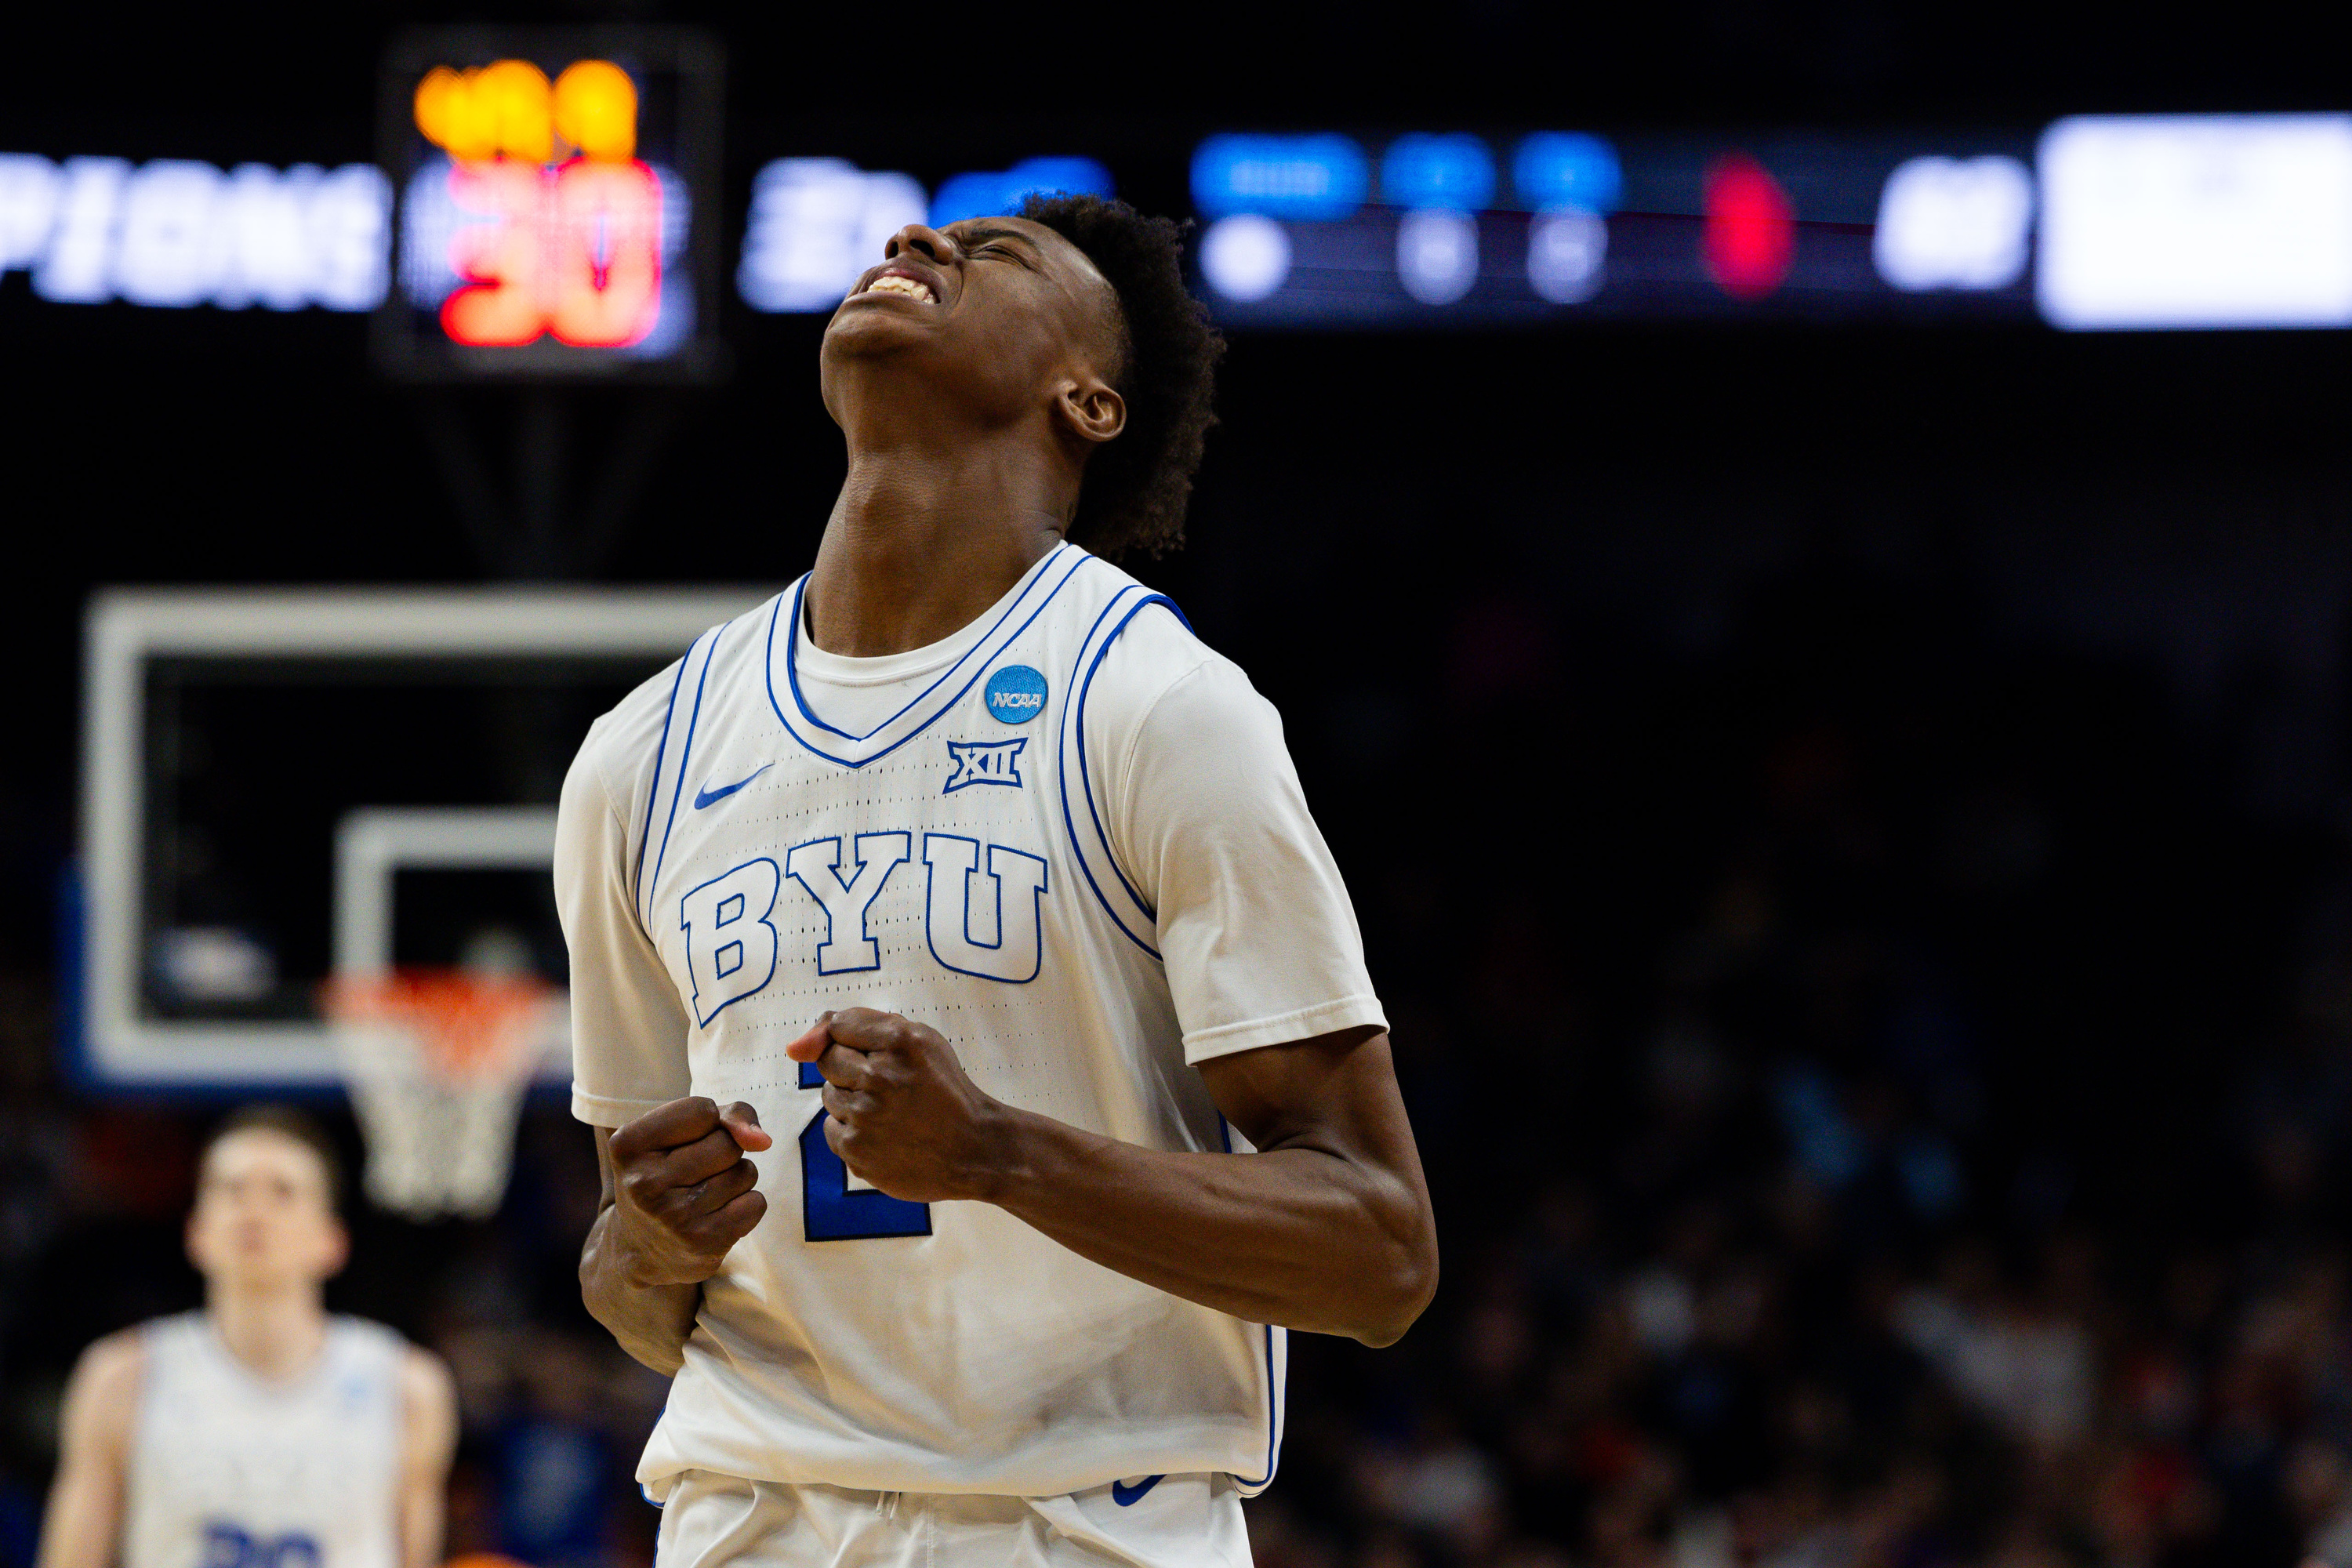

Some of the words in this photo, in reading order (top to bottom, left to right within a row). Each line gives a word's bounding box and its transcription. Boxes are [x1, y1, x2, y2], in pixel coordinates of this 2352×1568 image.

[992, 691, 1043, 708] NCAA
[944, 739, 1027, 793] XII
[680, 831, 1048, 1029] BYU
